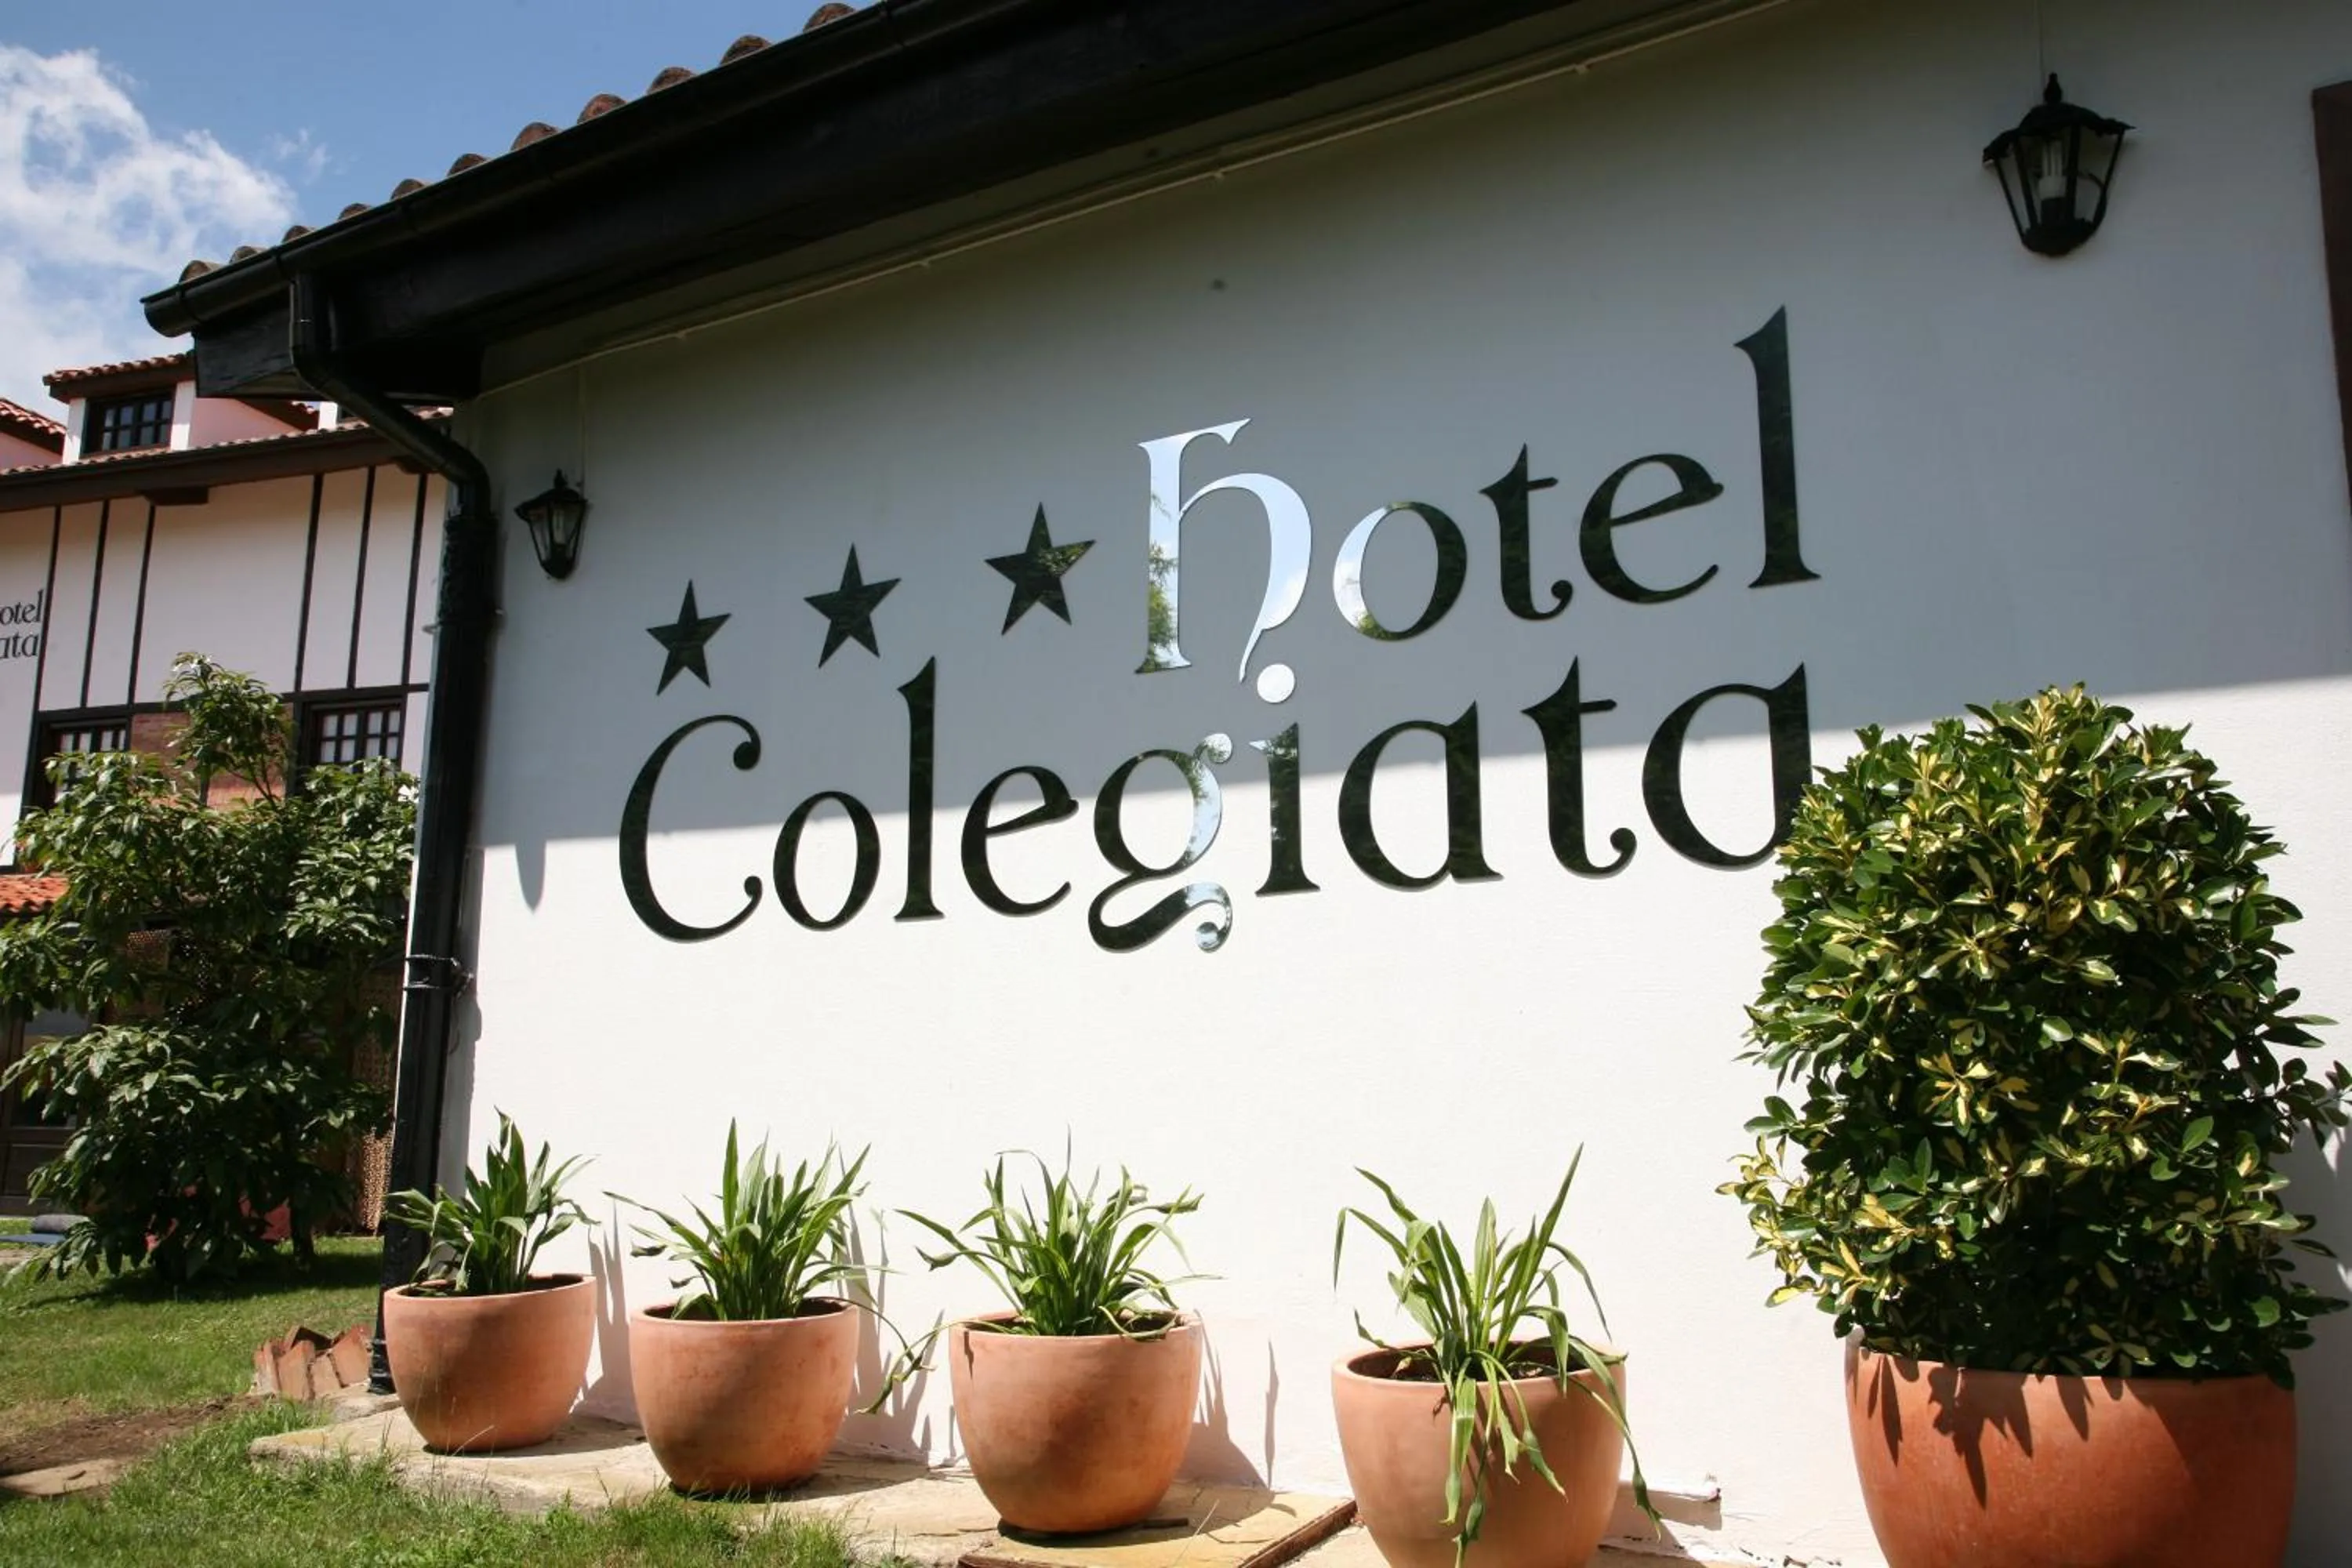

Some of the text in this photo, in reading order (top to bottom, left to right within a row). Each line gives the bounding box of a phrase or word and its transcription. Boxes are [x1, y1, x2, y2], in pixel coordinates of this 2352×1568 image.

[0, 589, 44, 626] otel
[1135, 304, 1821, 682] hotel
[619, 655, 1812, 953] Colegiata
